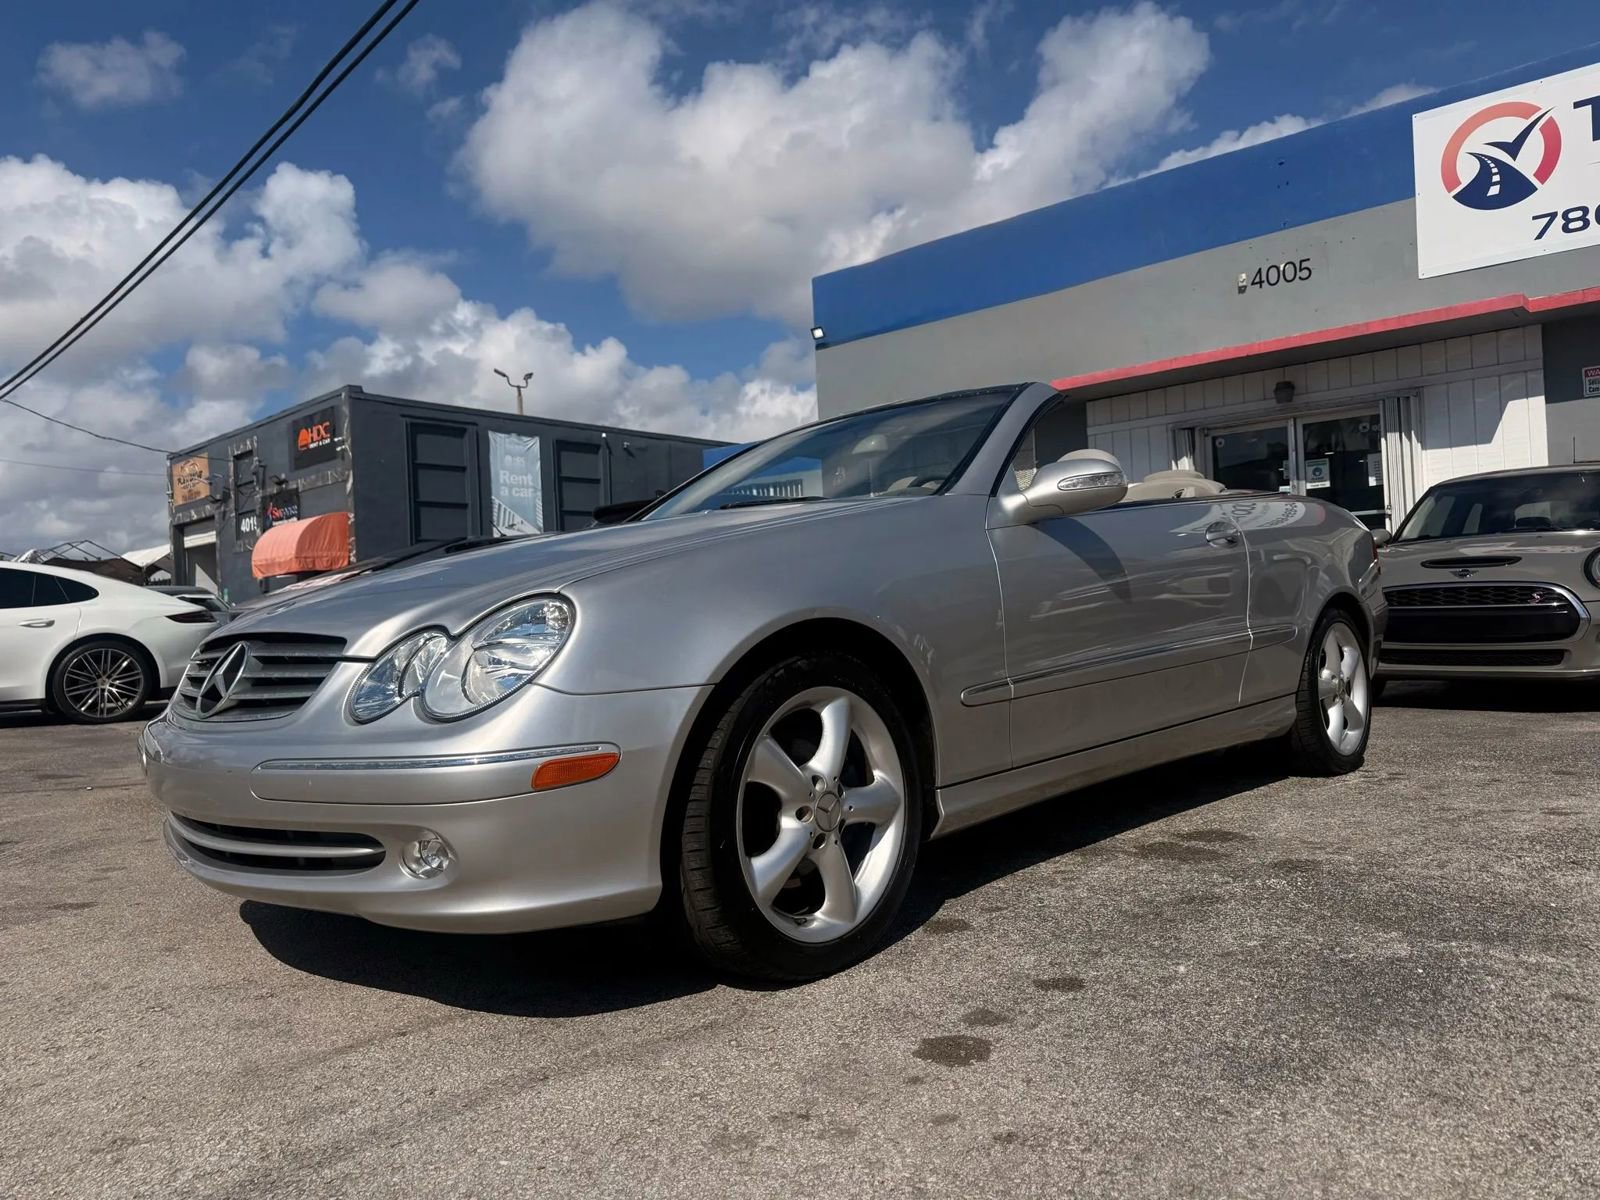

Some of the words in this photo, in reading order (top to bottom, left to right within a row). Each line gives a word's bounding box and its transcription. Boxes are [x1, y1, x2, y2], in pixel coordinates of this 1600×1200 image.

[1531, 204, 1600, 241] 78
[1250, 258, 1312, 289] 4005
[499, 470, 533, 486] Rent
[500, 486, 508, 496] a
[512, 487, 534, 497] car
